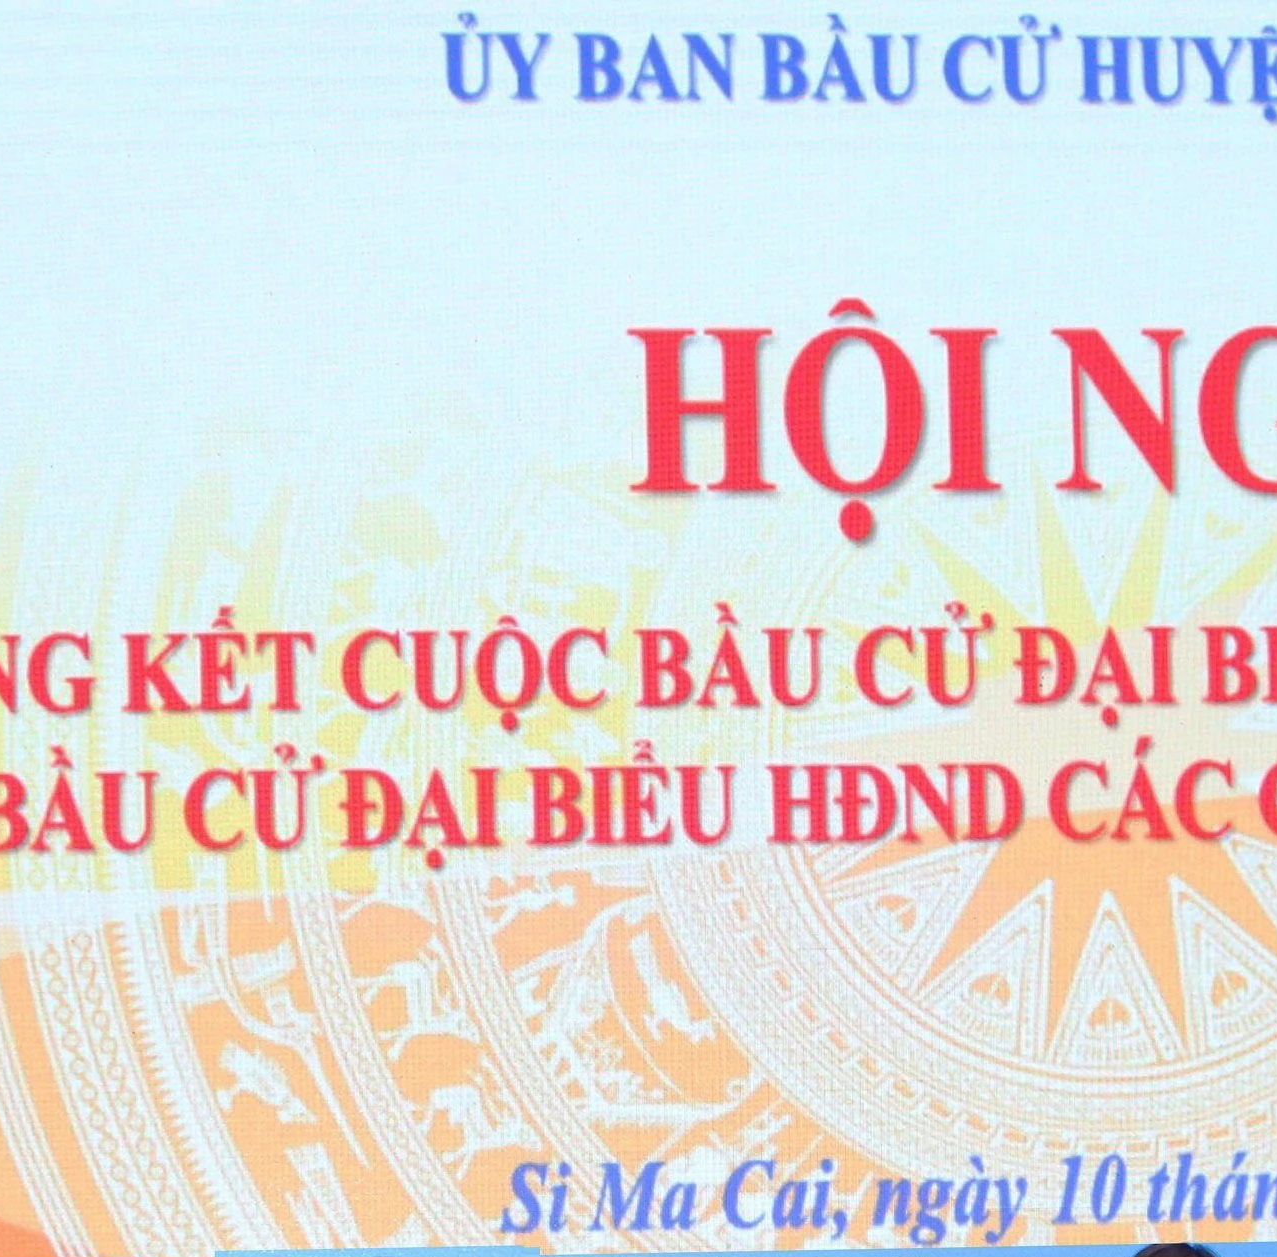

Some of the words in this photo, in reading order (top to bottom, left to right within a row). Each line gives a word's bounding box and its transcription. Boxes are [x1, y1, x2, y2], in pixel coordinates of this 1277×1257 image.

[441, 13, 550, 103] ỦY
[576, 33, 733, 100] BAN
[757, 12, 919, 103] BẦU
[944, 15, 1060, 102] CỬ
[631, 299, 999, 540] HỘI
[125, 606, 315, 713] KẾT
[342, 617, 605, 729] CUỘC
[639, 604, 820, 706] BẦU
[856, 602, 995, 706] CỬ
[1015, 627, 1174, 725] ĐẠI
[185, 746, 323, 848] CỬ
[342, 769, 499, 867] ĐẠI
[530, 740, 734, 846] BIỂU
[771, 764, 1022, 842] HĐND
[1049, 737, 1234, 842] CÁC
[502, 1161, 569, 1232] Si
[591, 1163, 696, 1230] Ma
[726, 1160, 847, 1238] Cai,
[875, 1157, 1029, 1247] ngày
[1054, 1155, 1125, 1223] 10
